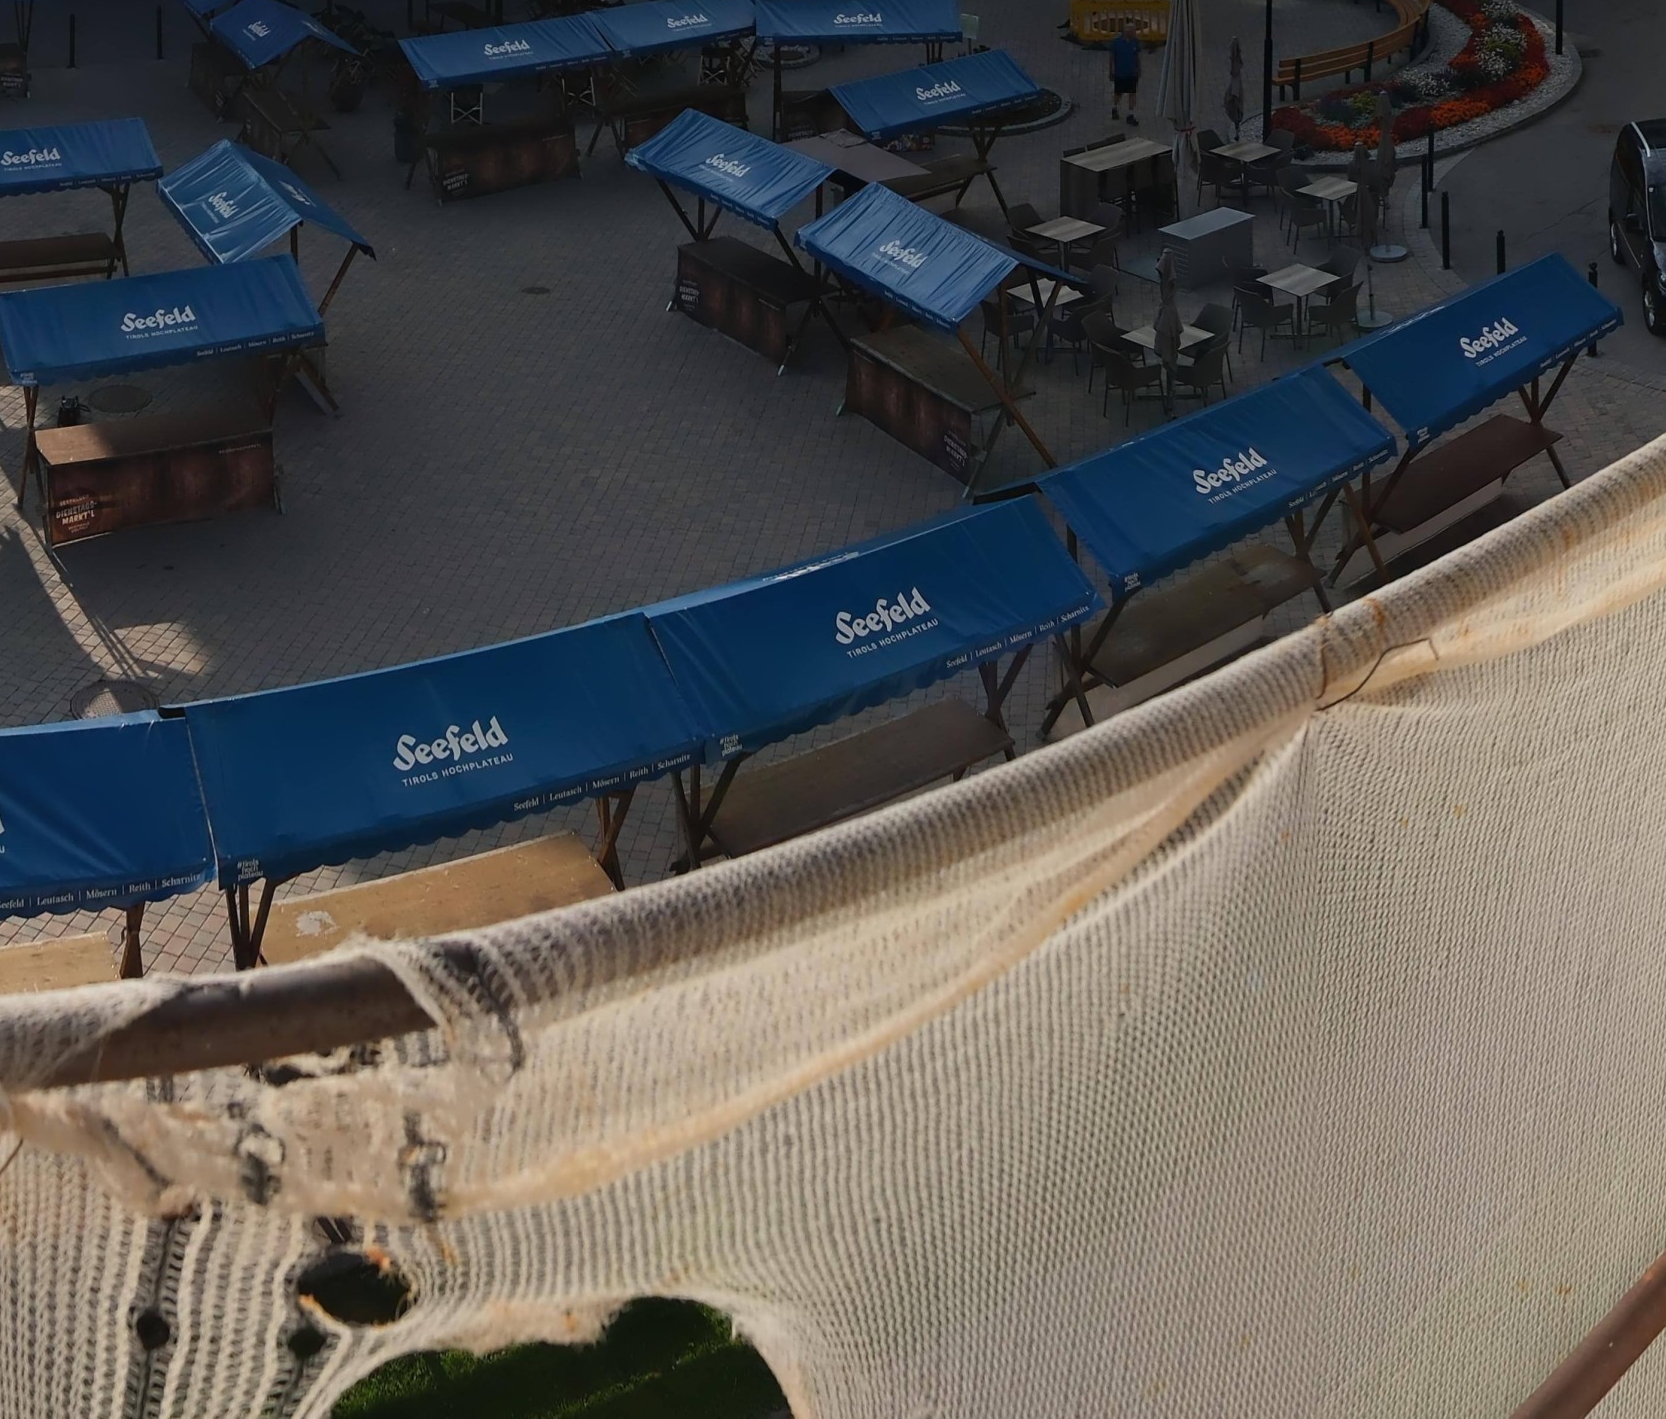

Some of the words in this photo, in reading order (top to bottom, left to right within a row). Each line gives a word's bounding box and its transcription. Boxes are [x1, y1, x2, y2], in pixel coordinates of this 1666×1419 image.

[667, 13, 709, 29] Seefeld
[833, 13, 882, 25] Seefeld
[483, 39, 530, 56] Seefeld
[916, 80, 961, 101] Seefeld
[0, 148, 61, 166] Seefeld
[706, 153, 749, 178] Seefeld
[208, 191, 239, 219] Seefeld
[879, 239, 929, 268] Seefeld
[121, 305, 196, 332] Seefeld
[1458, 317, 1519, 359] Seefeld
[1194, 447, 1268, 495] Seefeld
[1207, 488, 1231, 505] TIROLS
[1232, 468, 1278, 497] HOCHPLATEAU
[835, 587, 931, 644] Seefeld
[846, 642, 878, 659] TIROLS
[879, 618, 939, 647] HOCHPLATEAU
[946, 655, 968, 669] Seefeld
[975, 642, 1002, 658] Leutasch
[1009, 630, 1032, 644] Mösern
[1039, 619, 1055, 632] Reith
[1061, 605, 1090, 623] Scharnitz
[393, 716, 508, 771] Seefeld
[403, 771, 439, 787] TIROLS
[441, 753, 513, 777] HOCHPLATEAU
[513, 796, 539, 811] Seefeld
[549, 784, 582, 801] Leutasch
[591, 774, 620, 790] Mösern
[629, 765, 649, 779] Reith
[657, 753, 691, 771] Scharnitz
[37, 892, 74, 906] Leutasch
[86, 886, 117, 901] Mösern
[129, 881, 151, 894] Reith
[161, 872, 202, 888] Scharnitz
